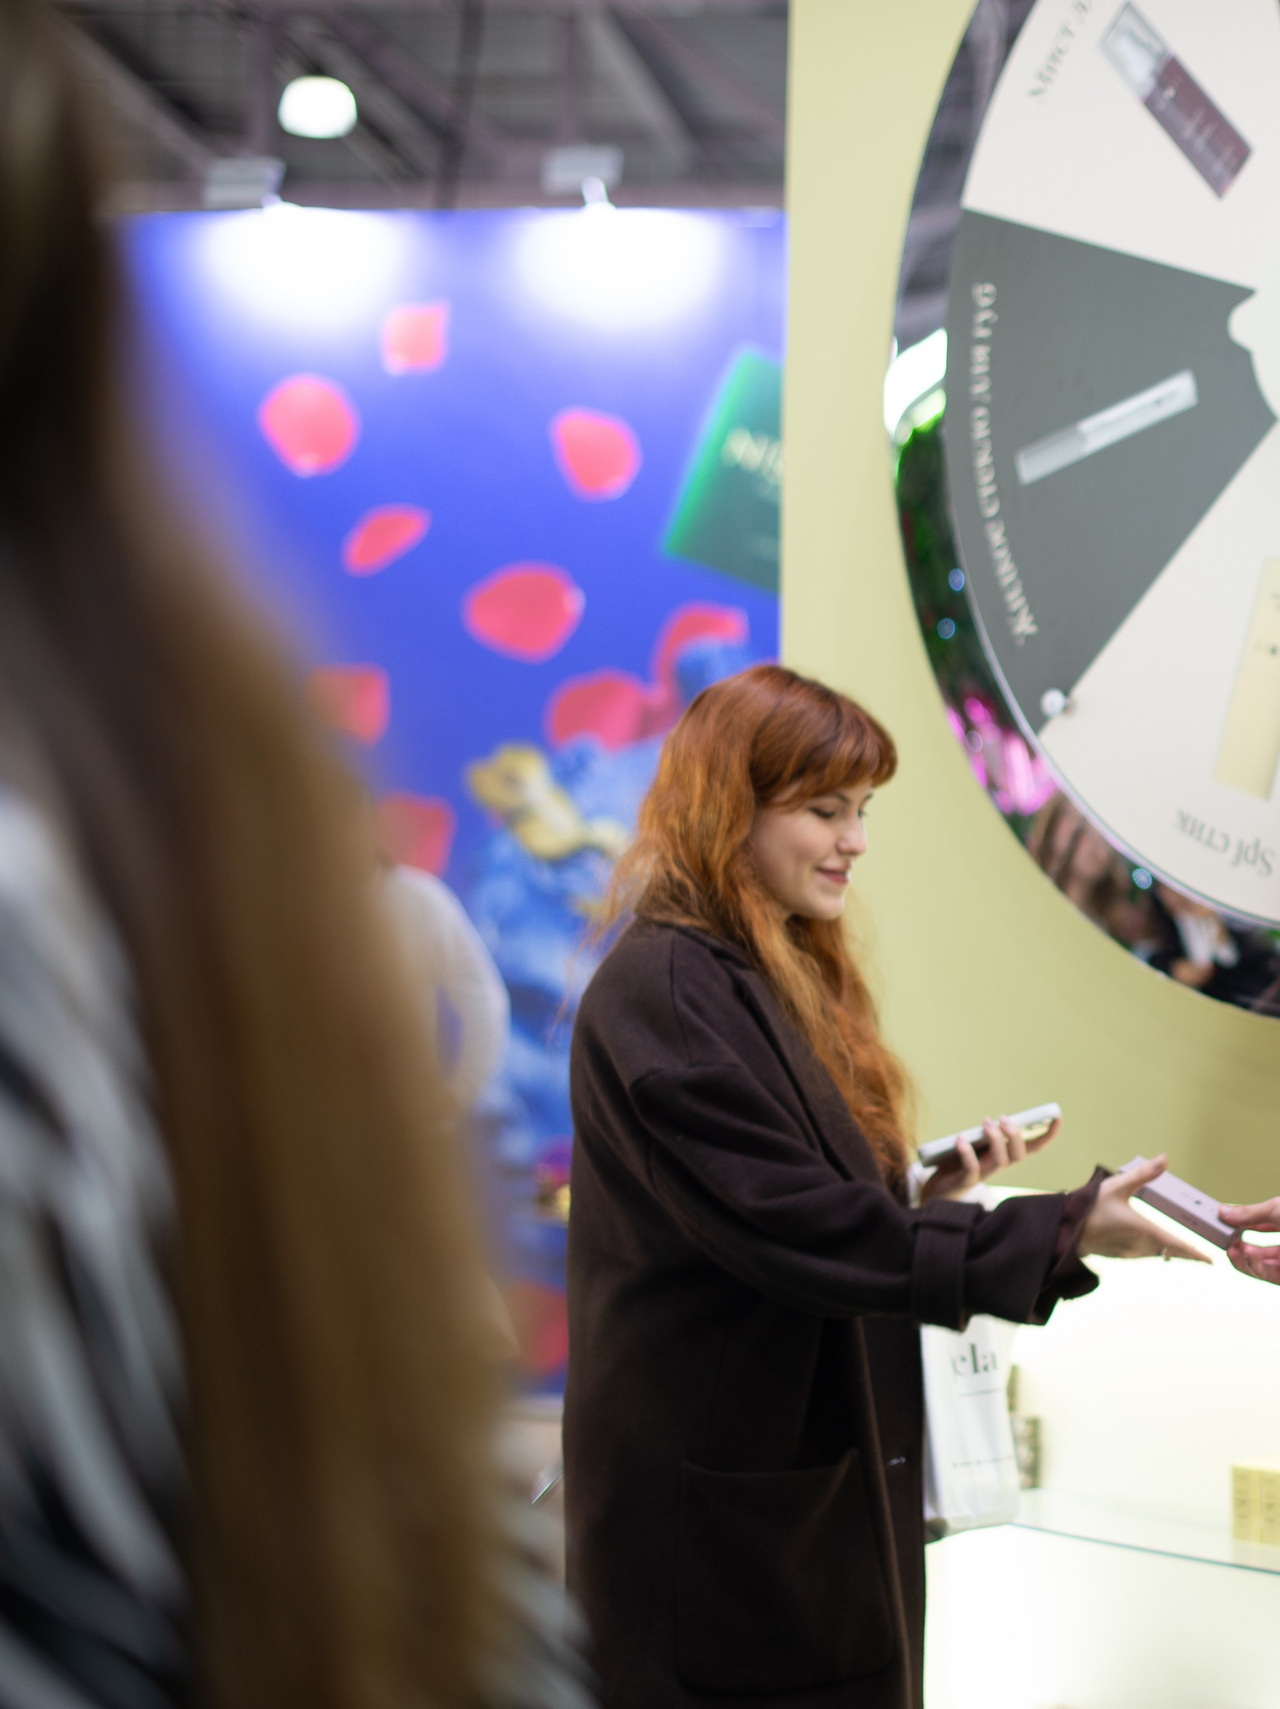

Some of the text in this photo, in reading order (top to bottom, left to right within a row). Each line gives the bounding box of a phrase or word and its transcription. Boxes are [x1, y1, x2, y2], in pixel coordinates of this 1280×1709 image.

[971, 282, 998, 338] губ
[969, 406, 1000, 518] стекло
[984, 519, 1038, 647] Жидкое
[1175, 808, 1230, 853] стик
